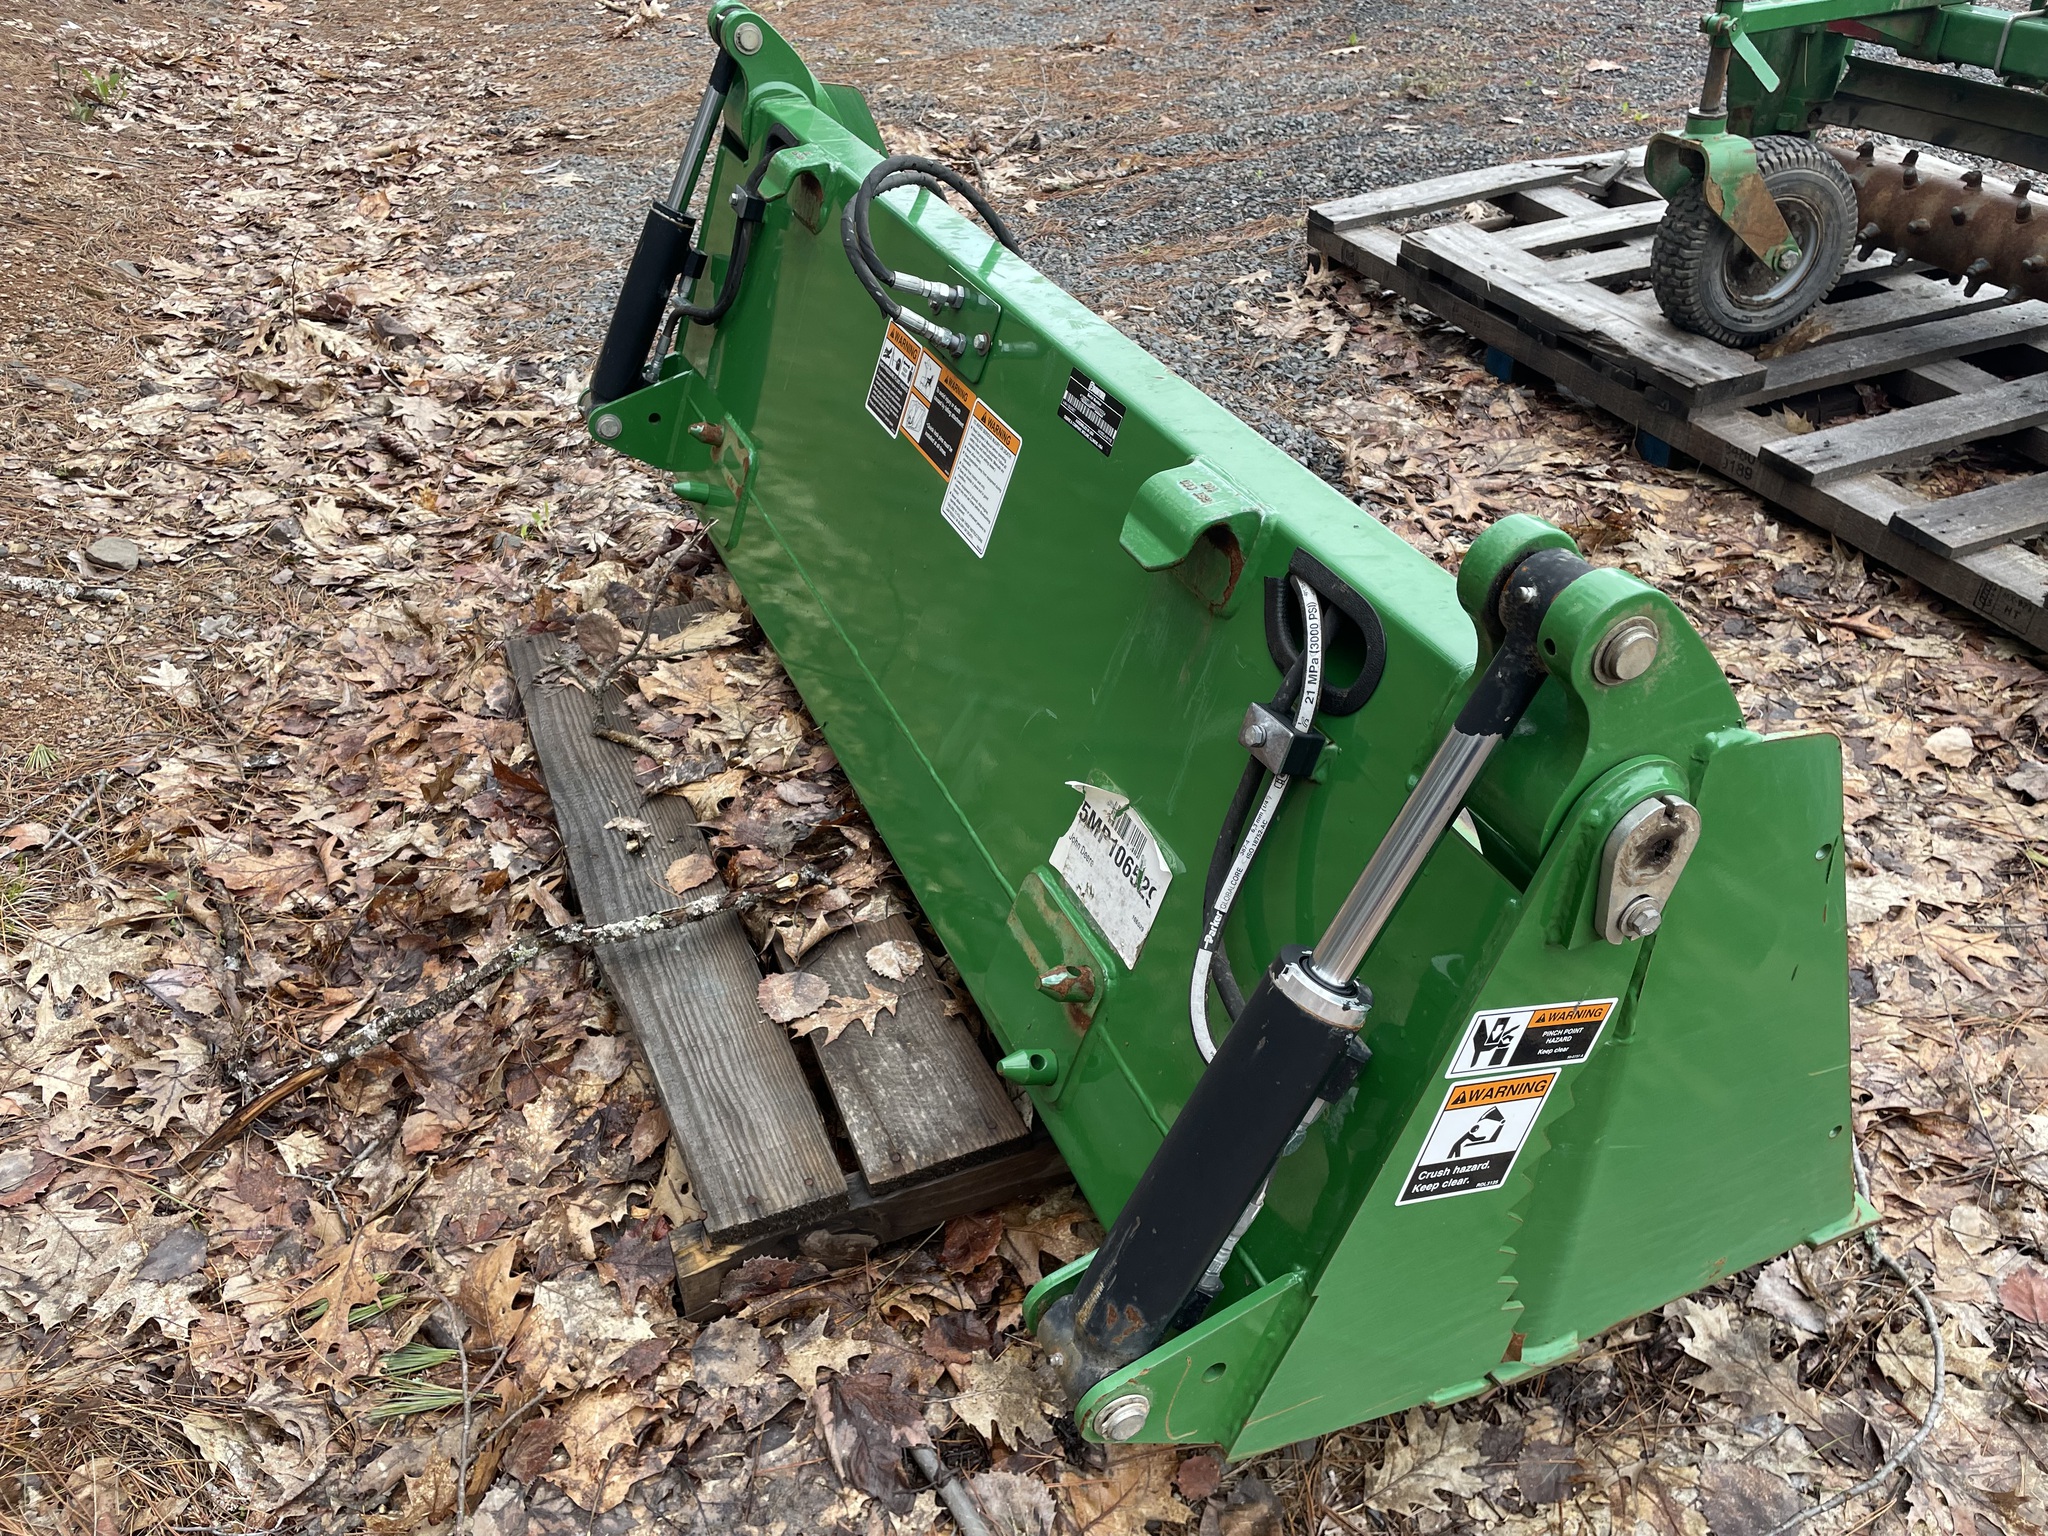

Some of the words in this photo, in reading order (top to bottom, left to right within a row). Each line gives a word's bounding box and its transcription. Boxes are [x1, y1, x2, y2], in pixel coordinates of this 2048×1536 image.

[894, 334, 918, 360] WARNING
[948, 379, 968, 402] WARNING
[987, 420, 1012, 446] WARNING
[1306, 602, 1319, 621] PSI)
[1309, 623, 1321, 654] (3000
[1307, 657, 1320, 685] MPa
[1305, 690, 1316, 705] 21
[1068, 832, 1081, 851] John
[1079, 845, 1095, 868] Deere
[1246, 847, 1255, 860] ISO
[1220, 867, 1244, 910] GLOBALCORE
[1204, 911, 1223, 949] Parker
[1548, 1008, 1603, 1022] WARNING
[1542, 1028, 1564, 1038] PINCH
[1563, 1026, 1584, 1036] POINT
[1545, 1035, 1573, 1045] HAZARD
[1537, 1048, 1554, 1056] Keep
[1553, 1046, 1570, 1054] clear
[1468, 1079, 1548, 1102] WARNING
[1418, 1167, 1451, 1181] Crush
[1452, 1160, 1491, 1175] hazard.
[1411, 1182, 1440, 1194] Keep
[1441, 1176, 1471, 1188] clear.
